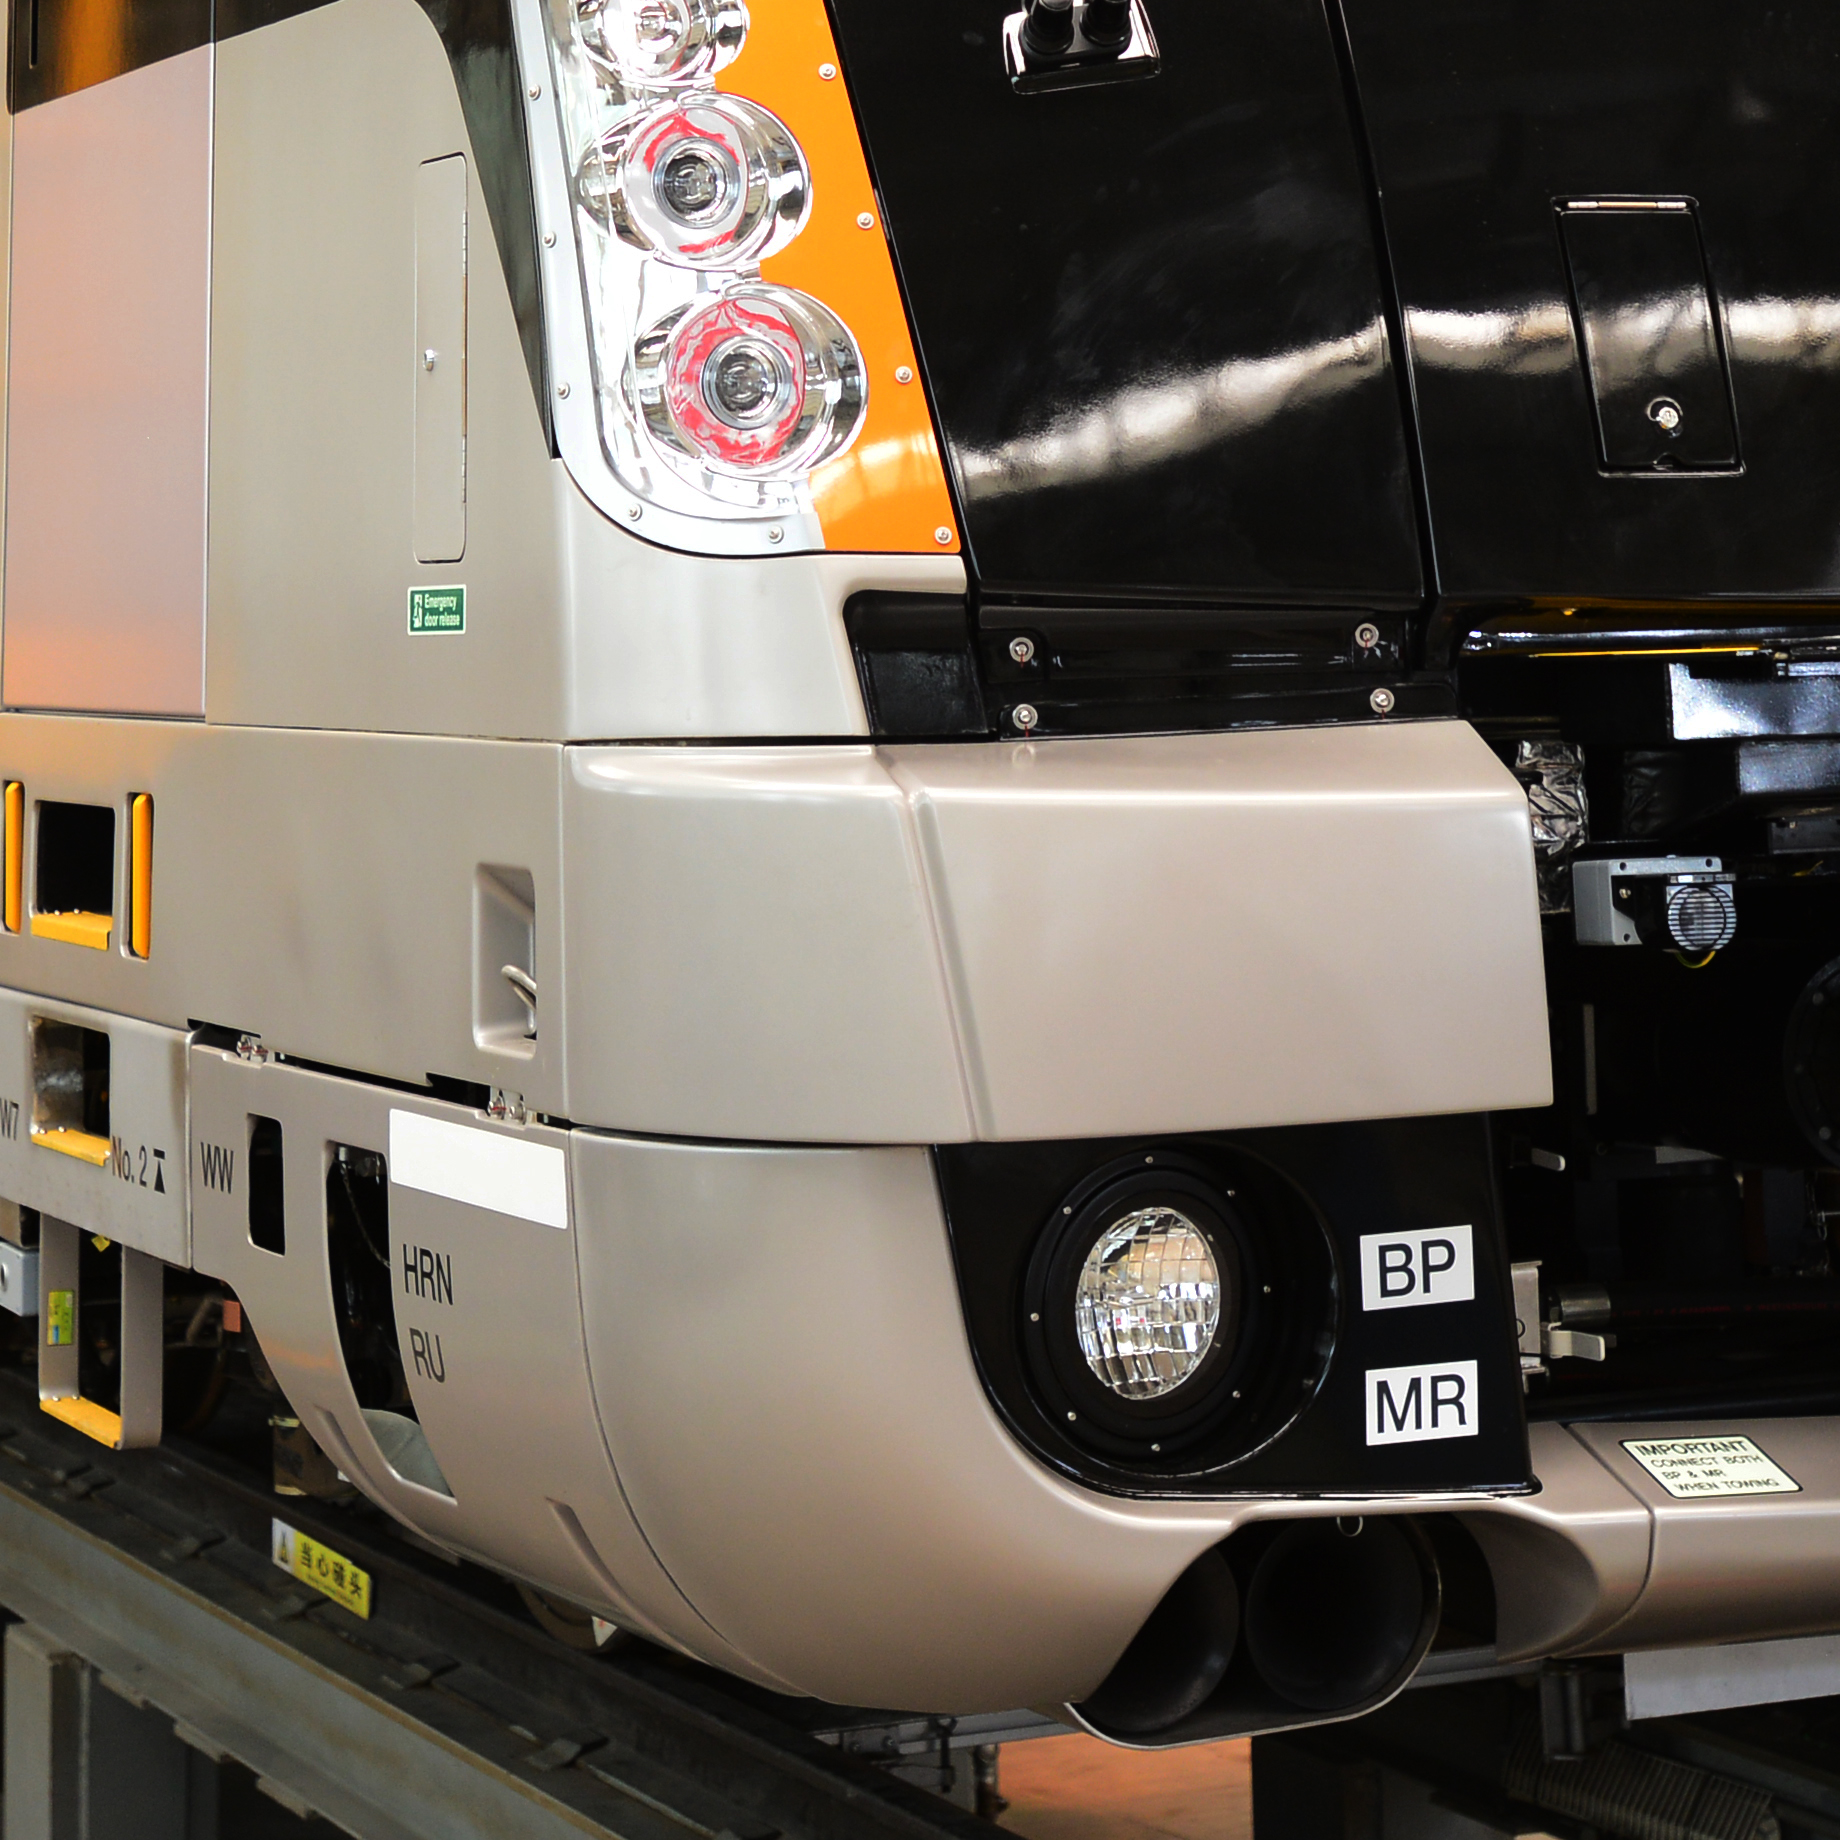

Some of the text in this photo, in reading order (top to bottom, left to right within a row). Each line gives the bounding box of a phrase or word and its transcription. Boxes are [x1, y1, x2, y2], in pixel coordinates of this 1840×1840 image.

[424, 611, 460, 627] door release
[425, 593, 457, 612] Emergency
[112, 1136, 148, 1188] No. 2
[200, 1142, 234, 1194] WW
[402, 1243, 454, 1306] HRN
[1377, 1238, 1456, 1299] BP
[409, 1326, 446, 1383] RU
[1376, 1373, 1467, 1434] MR
[1634, 1440, 1749, 1457] IMPORTANT
[1650, 1455, 1764, 1468] CONNECT BOTH
[1662, 1469, 1727, 1480] BP & MR
[1674, 1478, 1780, 1492] WHEN TOWING
